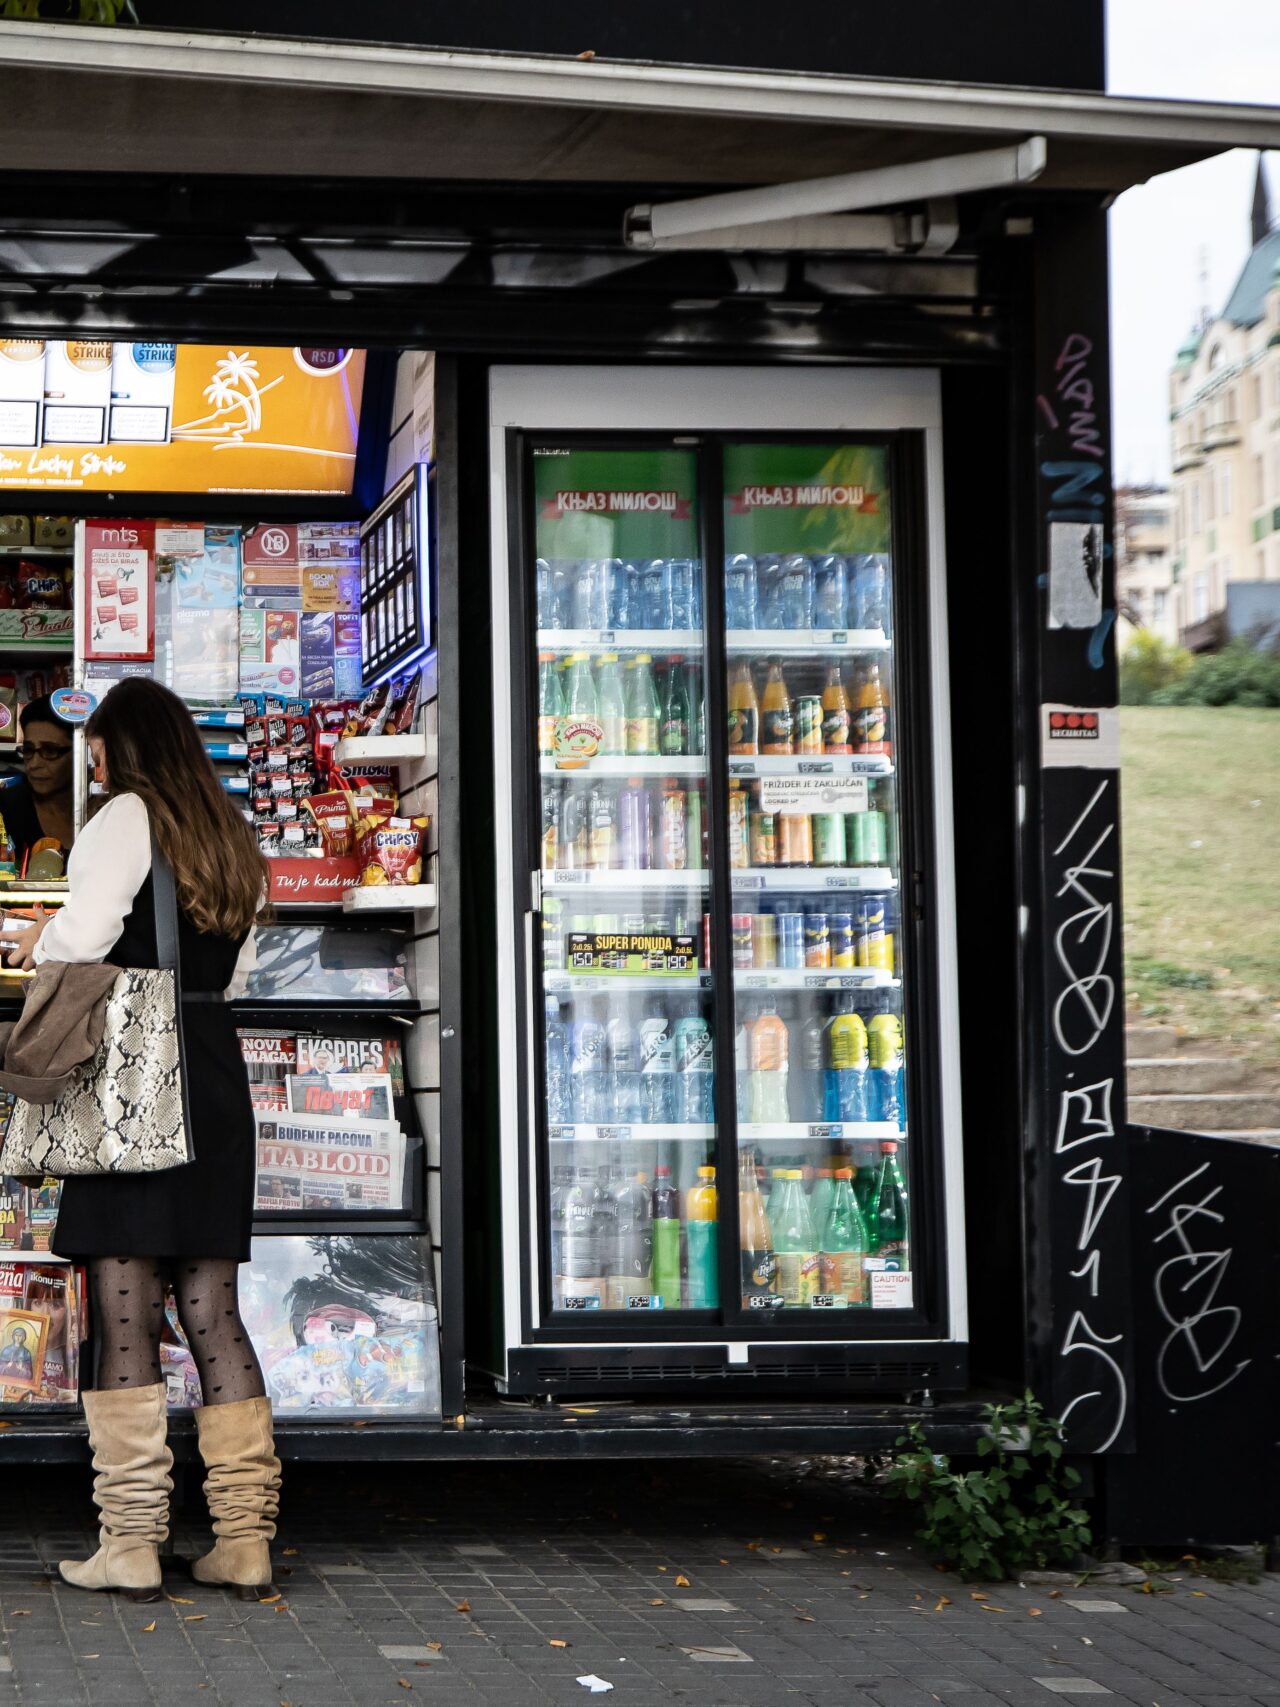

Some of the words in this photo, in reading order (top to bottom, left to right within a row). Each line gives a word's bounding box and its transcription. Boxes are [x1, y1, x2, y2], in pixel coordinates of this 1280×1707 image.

[73, 347, 112, 359] STRIKE
[138, 349, 176, 361] STRIKE
[311, 351, 335, 364] RSD
[27, 452, 74, 478] Lucky
[80, 452, 127, 477] Strike
[557, 492, 606, 510] КЊАЗ
[609, 492, 677, 511] МИЛОШ
[743, 486, 794, 506] КЊАЗ
[796, 486, 864, 505] МИЛОШ
[101, 526, 139, 542] mts
[1049, 728, 1099, 738] SECURITAS
[764, 779, 801, 789] FRIŽIDER
[803, 780, 812, 788] JE
[814, 778, 864, 788] ZAKLJUČAN
[276, 875, 296, 886] Tu
[296, 875, 309, 892] je
[314, 872, 341, 886] kad
[343, 875, 361, 886] mi
[596, 935, 629, 950] SUPER
[631, 936, 672, 950] PONUDA
[242, 1038, 282, 1051] NOVI
[644, 1031, 669, 1063] ZERO
[685, 1030, 711, 1060] ZERO
[297, 1038, 384, 1068] EKSPRES
[328, 1131, 373, 1148] PACOVA
[873, 1275, 910, 1284] CAUTION
